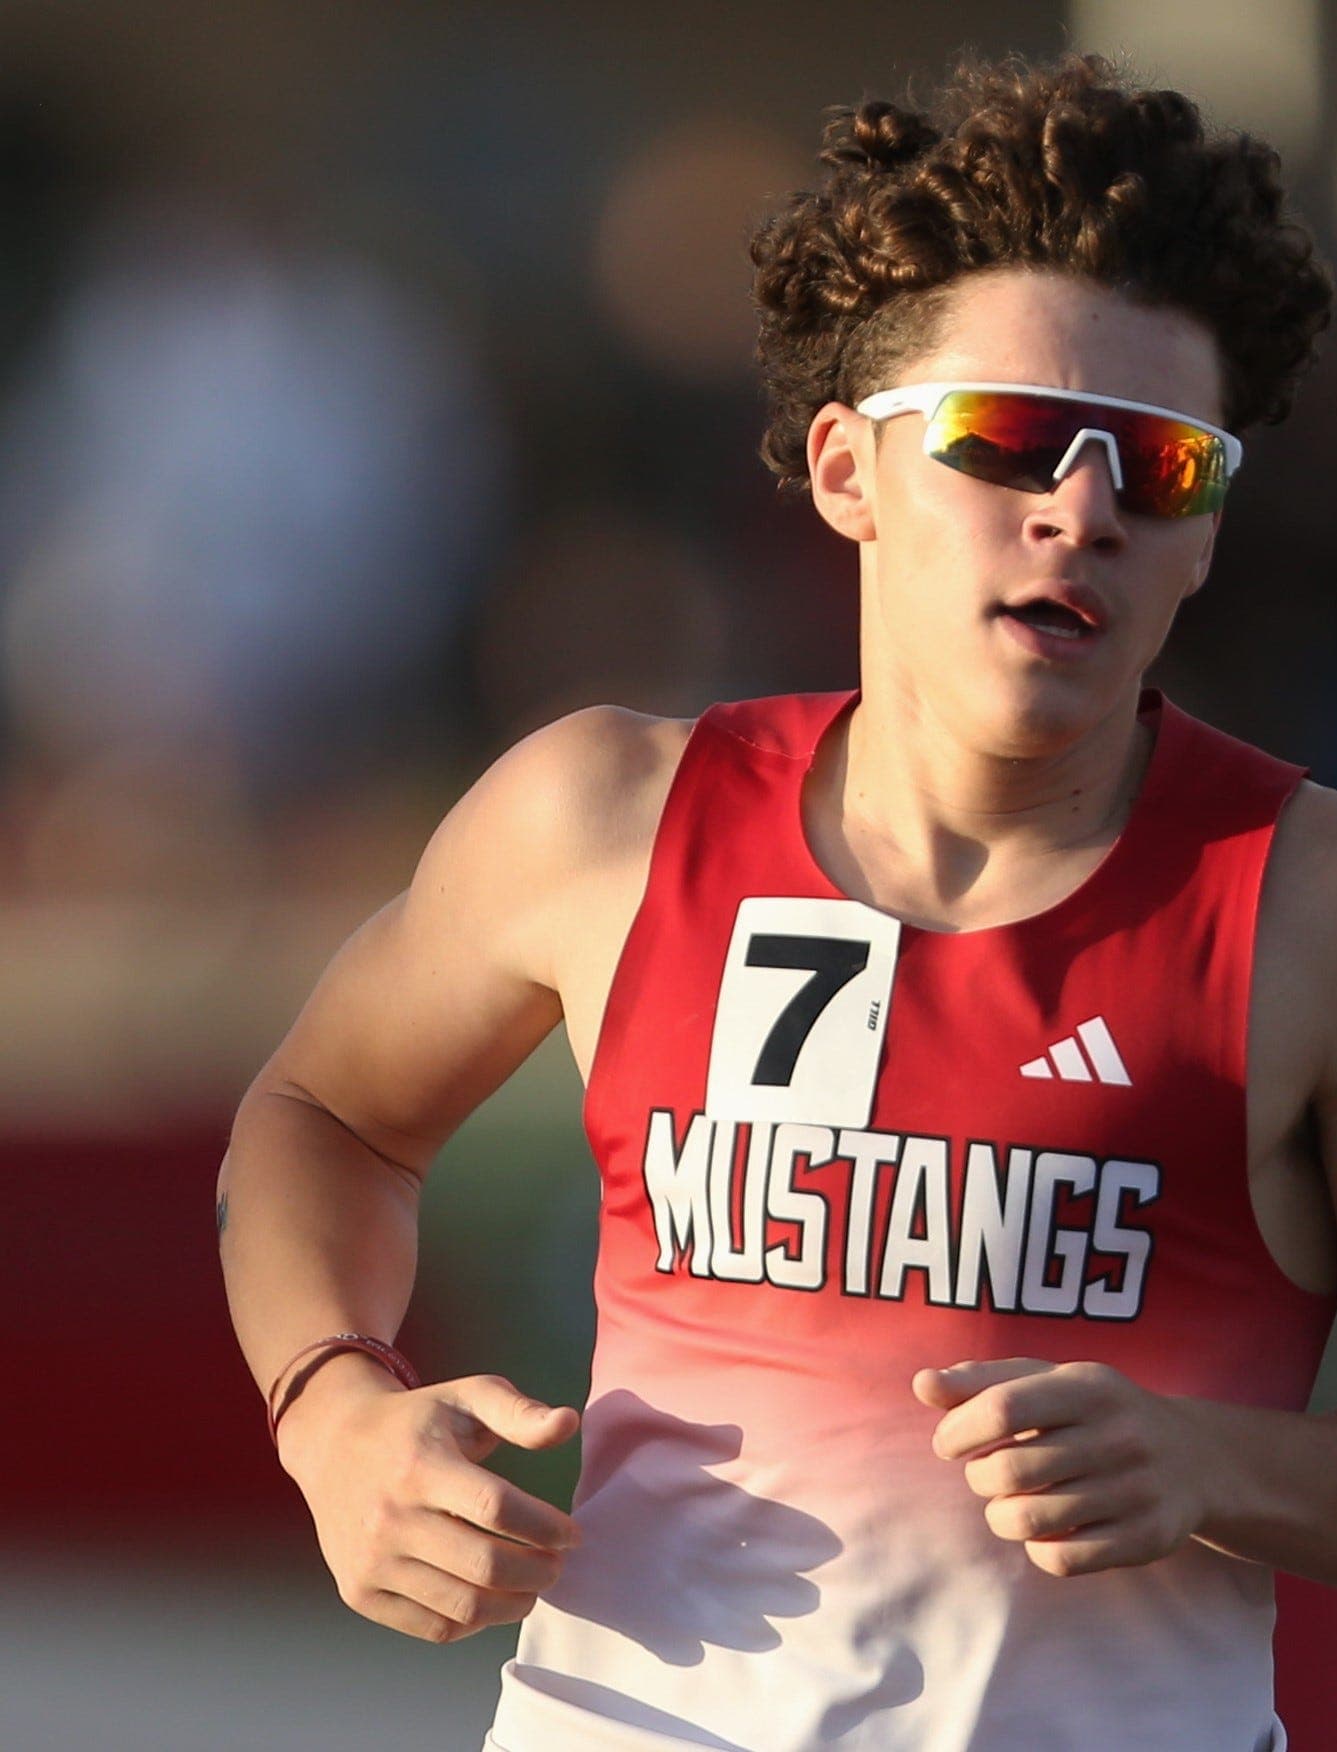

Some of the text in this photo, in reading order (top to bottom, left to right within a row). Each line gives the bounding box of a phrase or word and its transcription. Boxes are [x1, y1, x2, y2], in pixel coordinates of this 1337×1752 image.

[745, 934, 871, 1087] 7
[867, 1000, 881, 1031] GILL
[643, 1107, 1160, 1320] MUSTANGS
